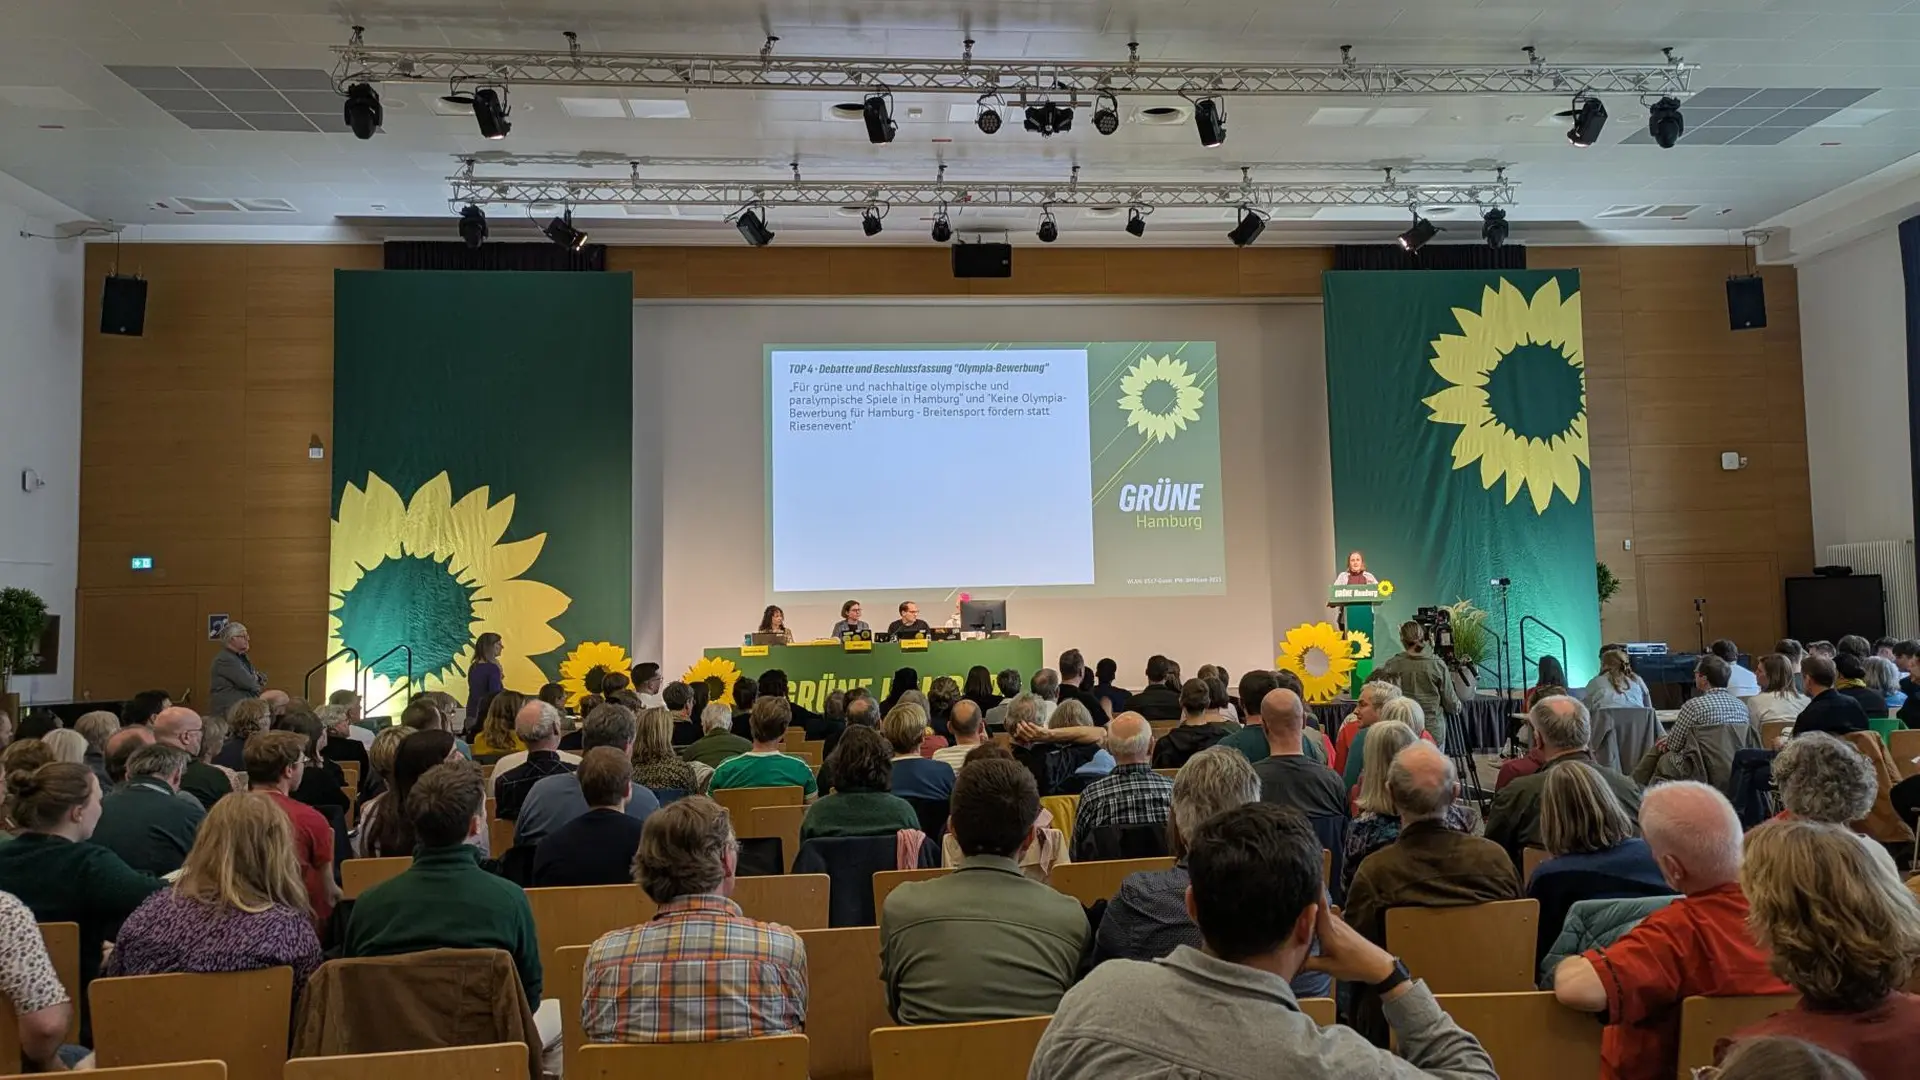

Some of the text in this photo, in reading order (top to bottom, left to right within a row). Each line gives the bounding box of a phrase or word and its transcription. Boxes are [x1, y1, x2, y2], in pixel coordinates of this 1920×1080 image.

[789, 364, 806, 374] TOP
[807, 364, 813, 373] 4
[819, 364, 854, 374] Debatte
[855, 364, 872, 373] und
[873, 363, 952, 375] Beschlussfassung
[813, 382, 843, 394] grüne
[846, 382, 865, 392] und
[868, 381, 927, 393] nachhaltige
[931, 381, 987, 392] olympische
[990, 381, 1009, 390] und
[789, 395, 863, 407] paralympische
[866, 394, 898, 406] Spiele
[901, 394, 911, 404] in
[966, 394, 985, 403] und
[1022, 393, 1067, 404] Olympia-
[789, 408, 847, 419] Bewerbung
[850, 408, 865, 418] für
[868, 408, 914, 419] Hamburg
[923, 407, 985, 418] Breitensport
[988, 406, 1024, 416] fördern
[1027, 407, 1050, 416] statt
[1119, 478, 1204, 512] GRÜNE
[1136, 514, 1203, 530] Hamburg
